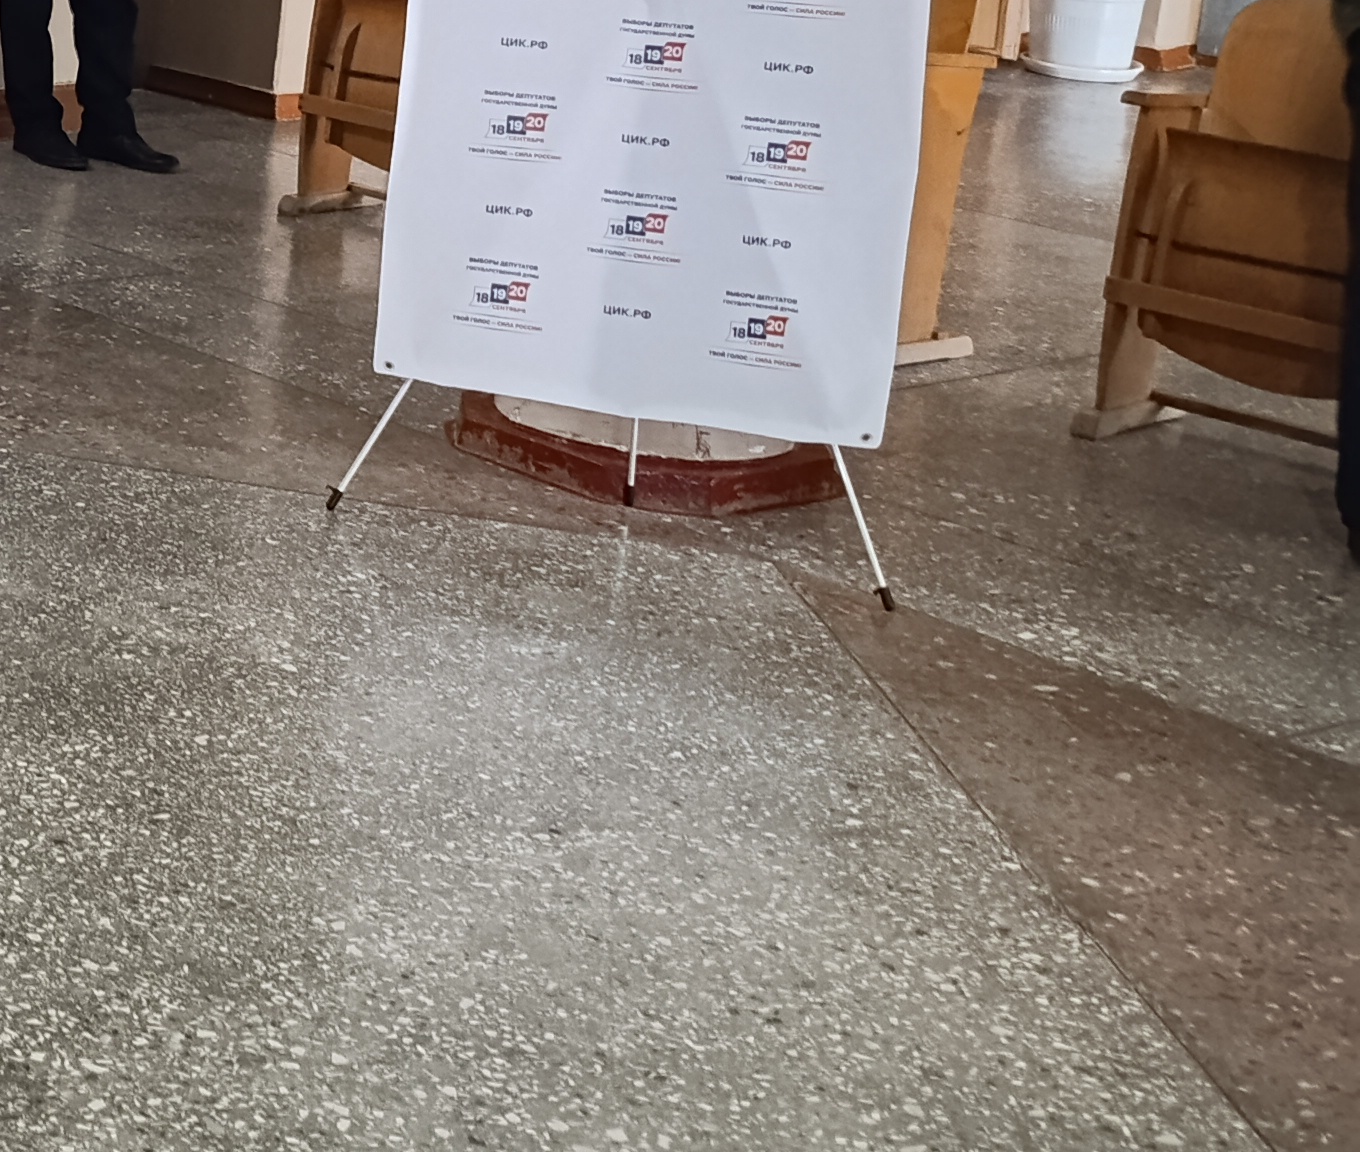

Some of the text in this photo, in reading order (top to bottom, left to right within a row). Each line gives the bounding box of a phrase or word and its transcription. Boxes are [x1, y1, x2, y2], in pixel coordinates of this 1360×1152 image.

[500, 37, 549, 50] ЦИК.РФ
[629, 46, 682, 65] 18 19 20
[763, 61, 814, 75] ЦИК.РФ
[491, 117, 544, 135] 18 19 20
[621, 134, 670, 148] ЦИК.РФ
[750, 145, 806, 163] 18 19 20
[485, 204, 534, 218] ЦИК.РФ
[610, 218, 664, 236] 18 19 20
[742, 234, 792, 250] ЦИК.РФ
[476, 286, 526, 304] 18 19 20
[603, 304, 652, 320] ЦИК.РФ
[732, 320, 784, 339] 18 19 20
